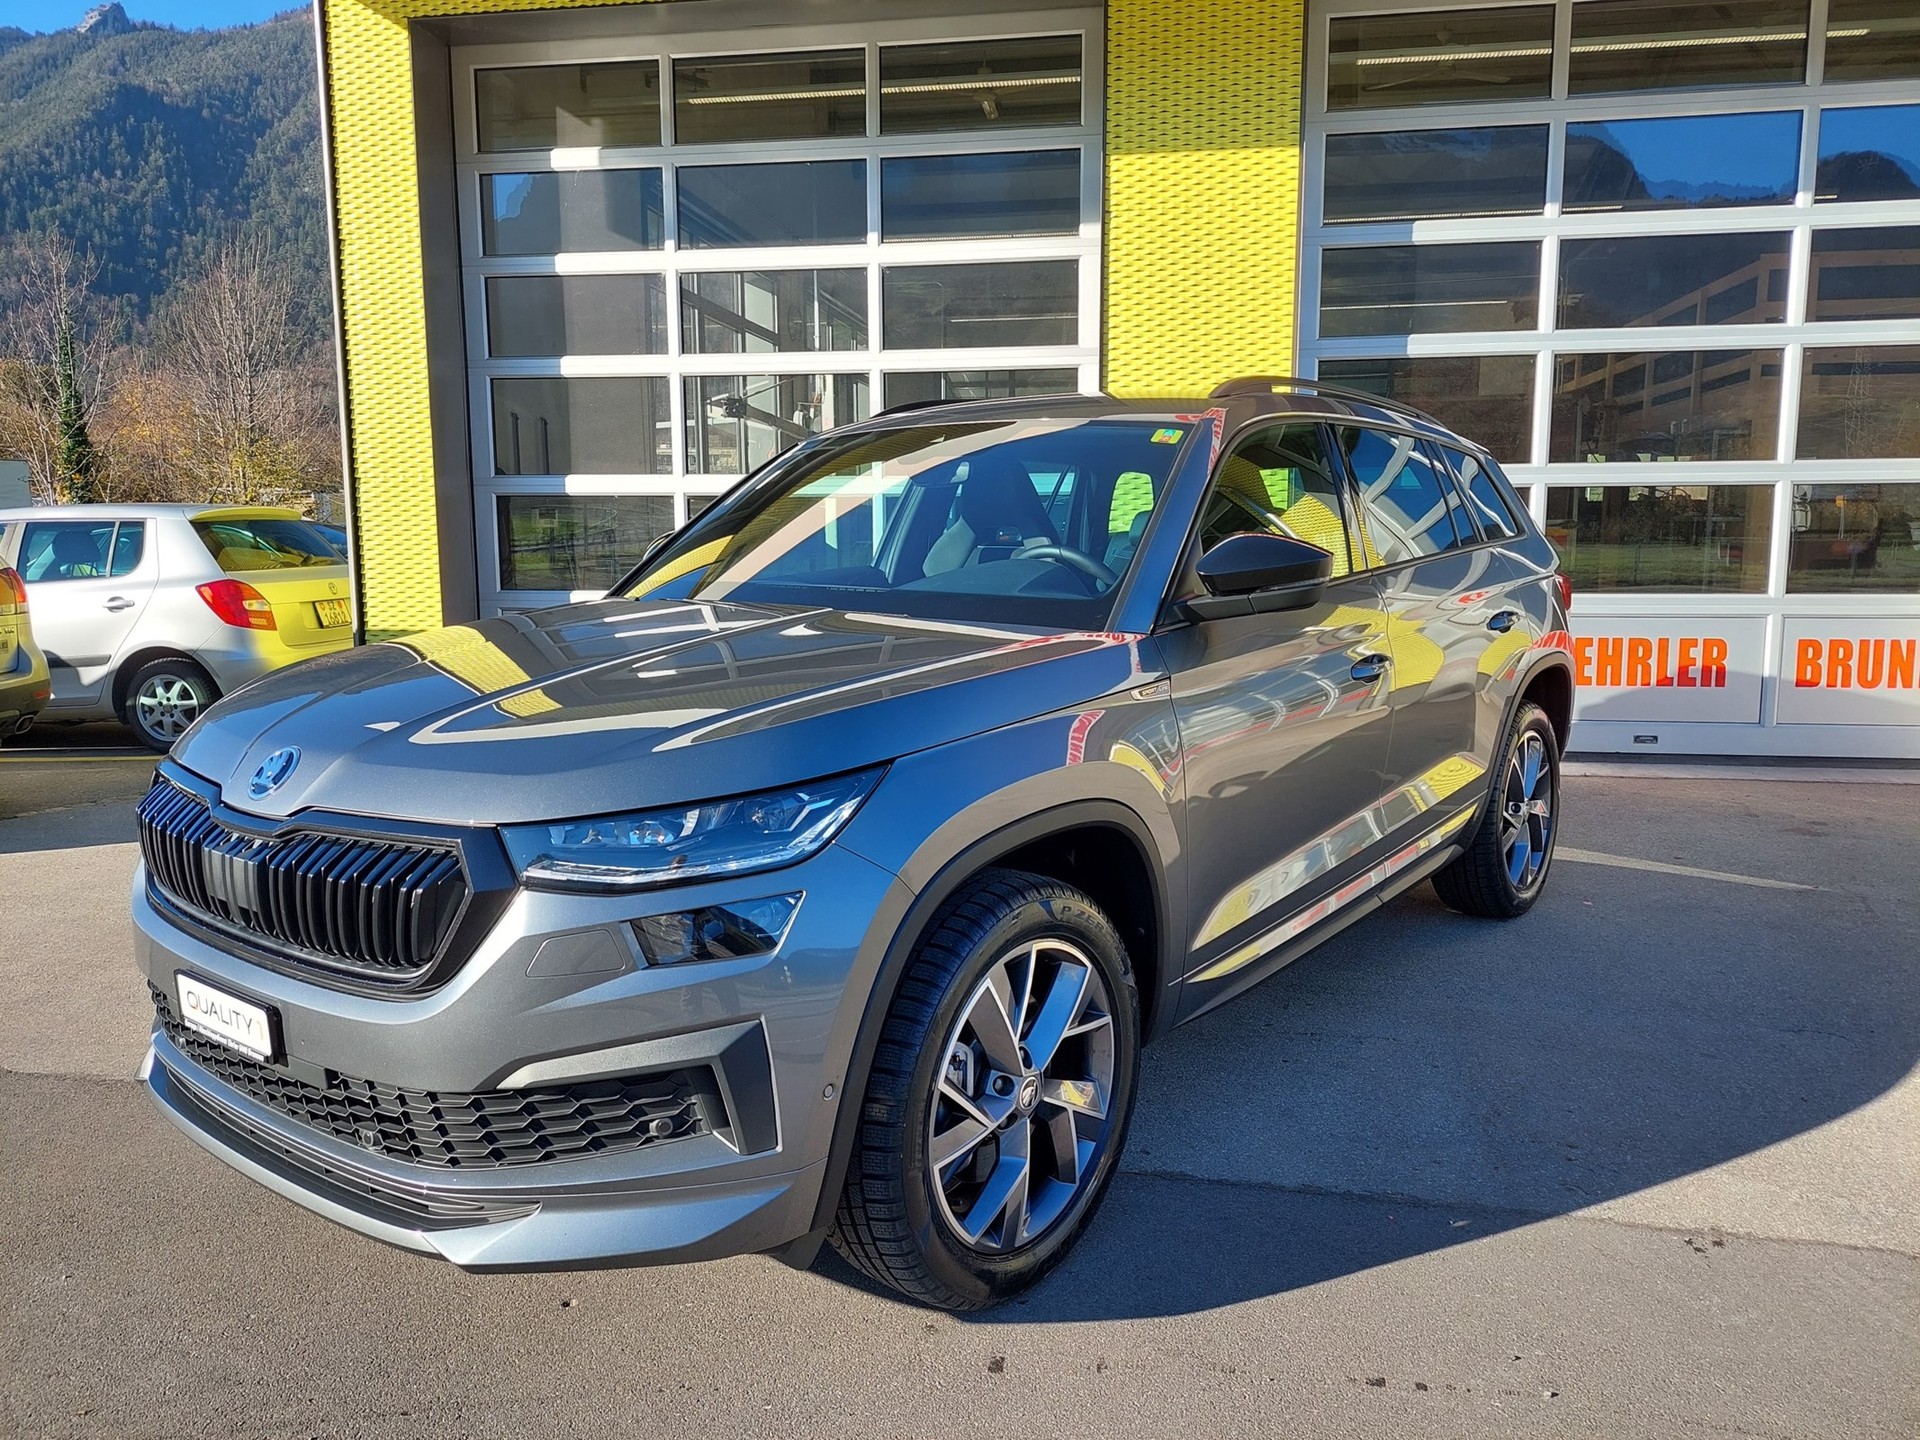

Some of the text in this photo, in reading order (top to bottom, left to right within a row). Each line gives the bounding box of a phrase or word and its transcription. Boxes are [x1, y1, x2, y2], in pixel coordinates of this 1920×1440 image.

[1575, 637, 1920, 689] EHRLER BRUN
[186, 990, 253, 1035] QUALITY
